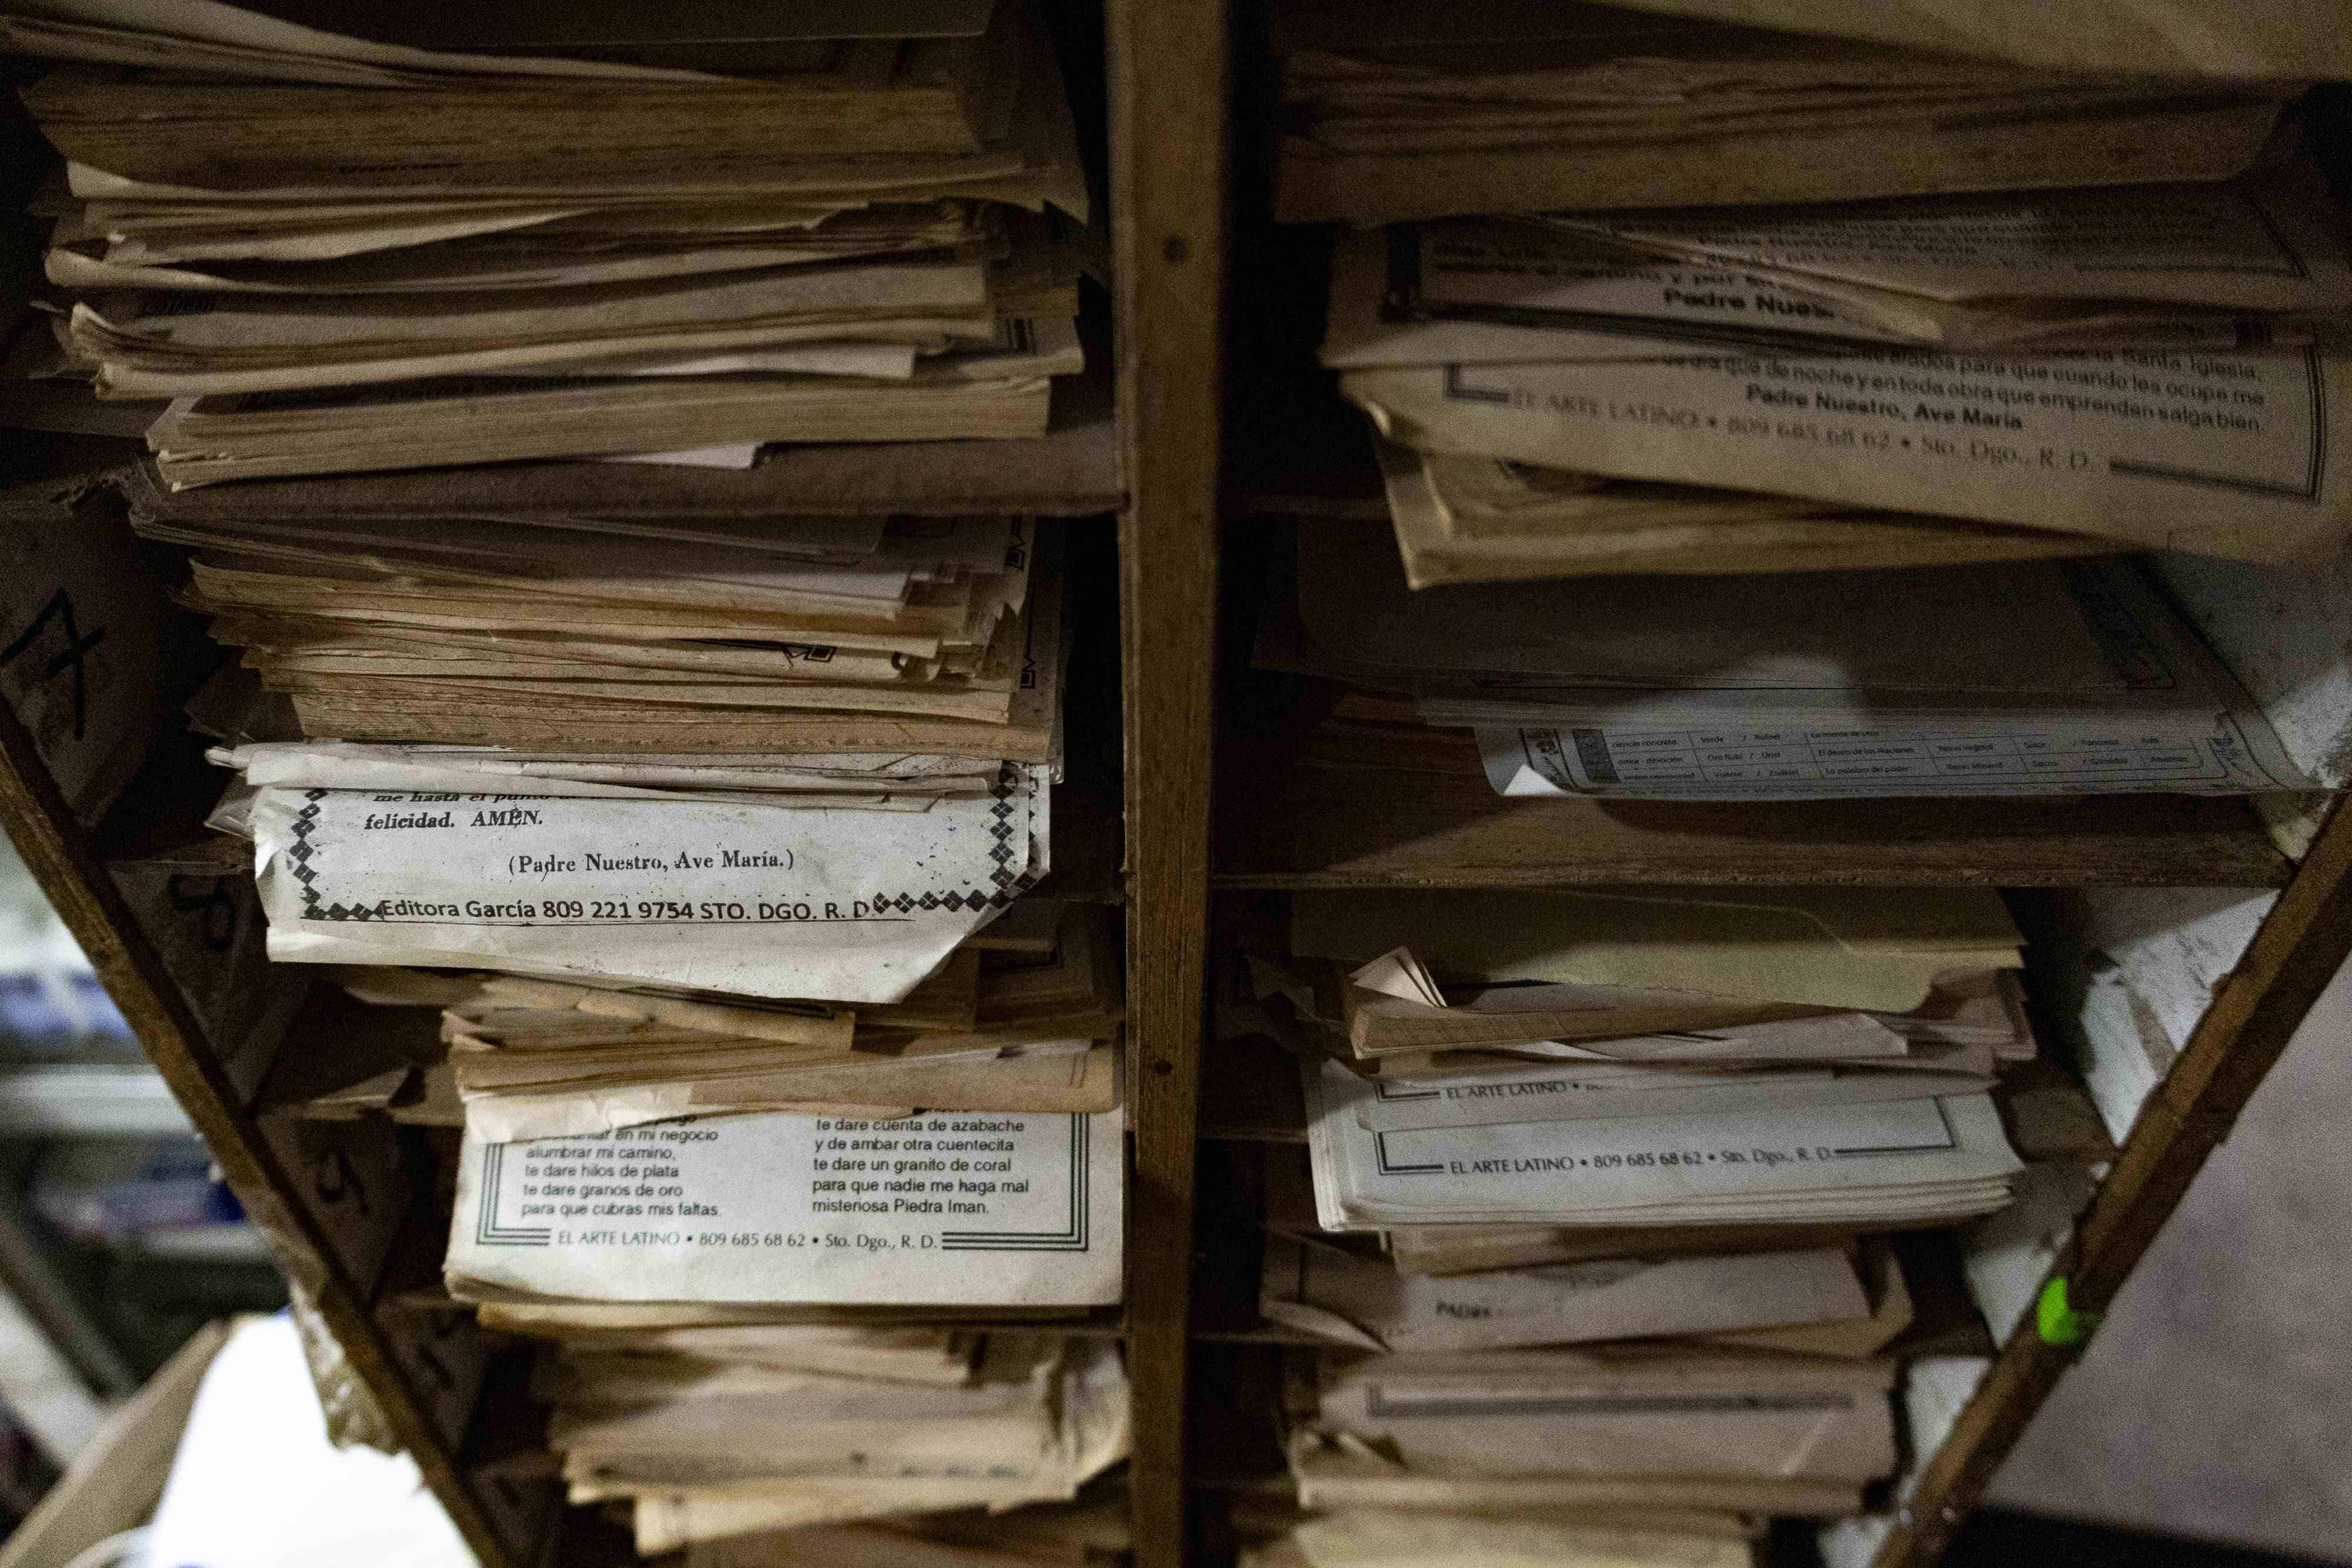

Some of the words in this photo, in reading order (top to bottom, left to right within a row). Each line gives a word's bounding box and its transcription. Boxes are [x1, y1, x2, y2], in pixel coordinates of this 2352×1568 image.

[1665, 287, 1746, 310] Padre
[1960, 357, 2006, 376] para
[2011, 361, 2048, 381] que
[2053, 369, 2128, 392] cuando
[2233, 389, 2266, 406] me
[1793, 365, 1855, 388] noche
[1856, 372, 1869, 393] y
[1899, 376, 1945, 397] toda
[1947, 380, 1994, 401] obra
[1997, 386, 2036, 407] que
[2039, 392, 2155, 420] emprendan
[1746, 382, 1809, 409] Padre
[1815, 390, 1908, 423] Nuestro,
[1913, 402, 1956, 424] Ave
[363, 811, 456, 831] felicidad.
[507, 854, 576, 875] (Padre
[584, 852, 669, 872] Nuestro,
[674, 851, 714, 869] Ave
[721, 848, 795, 870] María.)
[380, 900, 460, 918] Editora
[465, 898, 536, 919] García
[542, 900, 584, 919] 809
[590, 901, 632, 919] 221
[637, 901, 694, 920] 9754
[700, 901, 753, 920] STO.
[759, 901, 818, 920] DGO.
[824, 901, 846, 919] R.
[1446, 1086, 1468, 1100] EL
[1469, 1084, 1506, 1099] ARTE
[1508, 1081, 1568, 1097] LATINO
[816, 1119, 831, 1131] te
[834, 1118, 869, 1131] dare
[873, 1119, 923, 1132] cuenta
[927, 1119, 947, 1132] de
[950, 1119, 1025, 1132] azabache
[638, 1129, 656, 1141] mi
[660, 1129, 719, 1145] negocio
[814, 1140, 824, 1153] y
[827, 1138, 847, 1151] de
[850, 1138, 899, 1151] ambar
[902, 1139, 933, 1151] otra
[936, 1138, 1016, 1152] cuentecita
[525, 1147, 592, 1160] alumbrar
[595, 1147, 615, 1159] mi
[617, 1148, 676, 1162] camino,
[1449, 1160, 1469, 1175] EL
[1471, 1159, 1511, 1174] ARTE
[1514, 1156, 1576, 1173] LATINO
[1593, 1154, 1623, 1169] 809
[1626, 1151, 1656, 1167] 685
[1659, 1151, 1680, 1166] 68
[1682, 1151, 1702, 1166] 62
[524, 1165, 540, 1177] te
[542, 1165, 578, 1177] dare
[580, 1164, 616, 1177] hilos
[618, 1164, 639, 1177] de
[642, 1165, 680, 1180] plata
[813, 1159, 828, 1171] te
[831, 1158, 867, 1171] dare
[870, 1161, 890, 1172] un
[893, 1159, 947, 1175] granito
[950, 1159, 970, 1172] de
[973, 1159, 1012, 1173] coral
[522, 1183, 539, 1196] te
[540, 1183, 577, 1196] dare
[579, 1185, 632, 1200] granos
[634, 1183, 656, 1196] de
[657, 1185, 684, 1197] oro
[811, 1181, 847, 1194] para
[850, 1181, 880, 1196] que
[883, 1179, 926, 1192] nadie
[930, 1182, 954, 1193] me
[958, 1179, 997, 1196] haga
[1001, 1179, 1030, 1193] mal
[520, 1203, 556, 1218] para
[559, 1205, 589, 1218] que
[591, 1202, 644, 1216] cubras
[647, 1202, 675, 1216] mis
[677, 1202, 721, 1217] faltas.
[811, 1199, 889, 1213] misteriosa
[893, 1198, 943, 1213] Piedra
[947, 1199, 991, 1214] Iman.
[557, 1231, 576, 1245] EL
[578, 1231, 616, 1246] ARTE
[620, 1231, 681, 1246] LATINO
[698, 1232, 728, 1247] 809
[731, 1232, 760, 1247] 685
[763, 1232, 783, 1248] 68
[786, 1232, 806, 1248] 62
[824, 1233, 853, 1249] Sto.
[856, 1233, 897, 1253] Dgo.,
[900, 1233, 917, 1249] R.
[919, 1234, 939, 1250] D.
